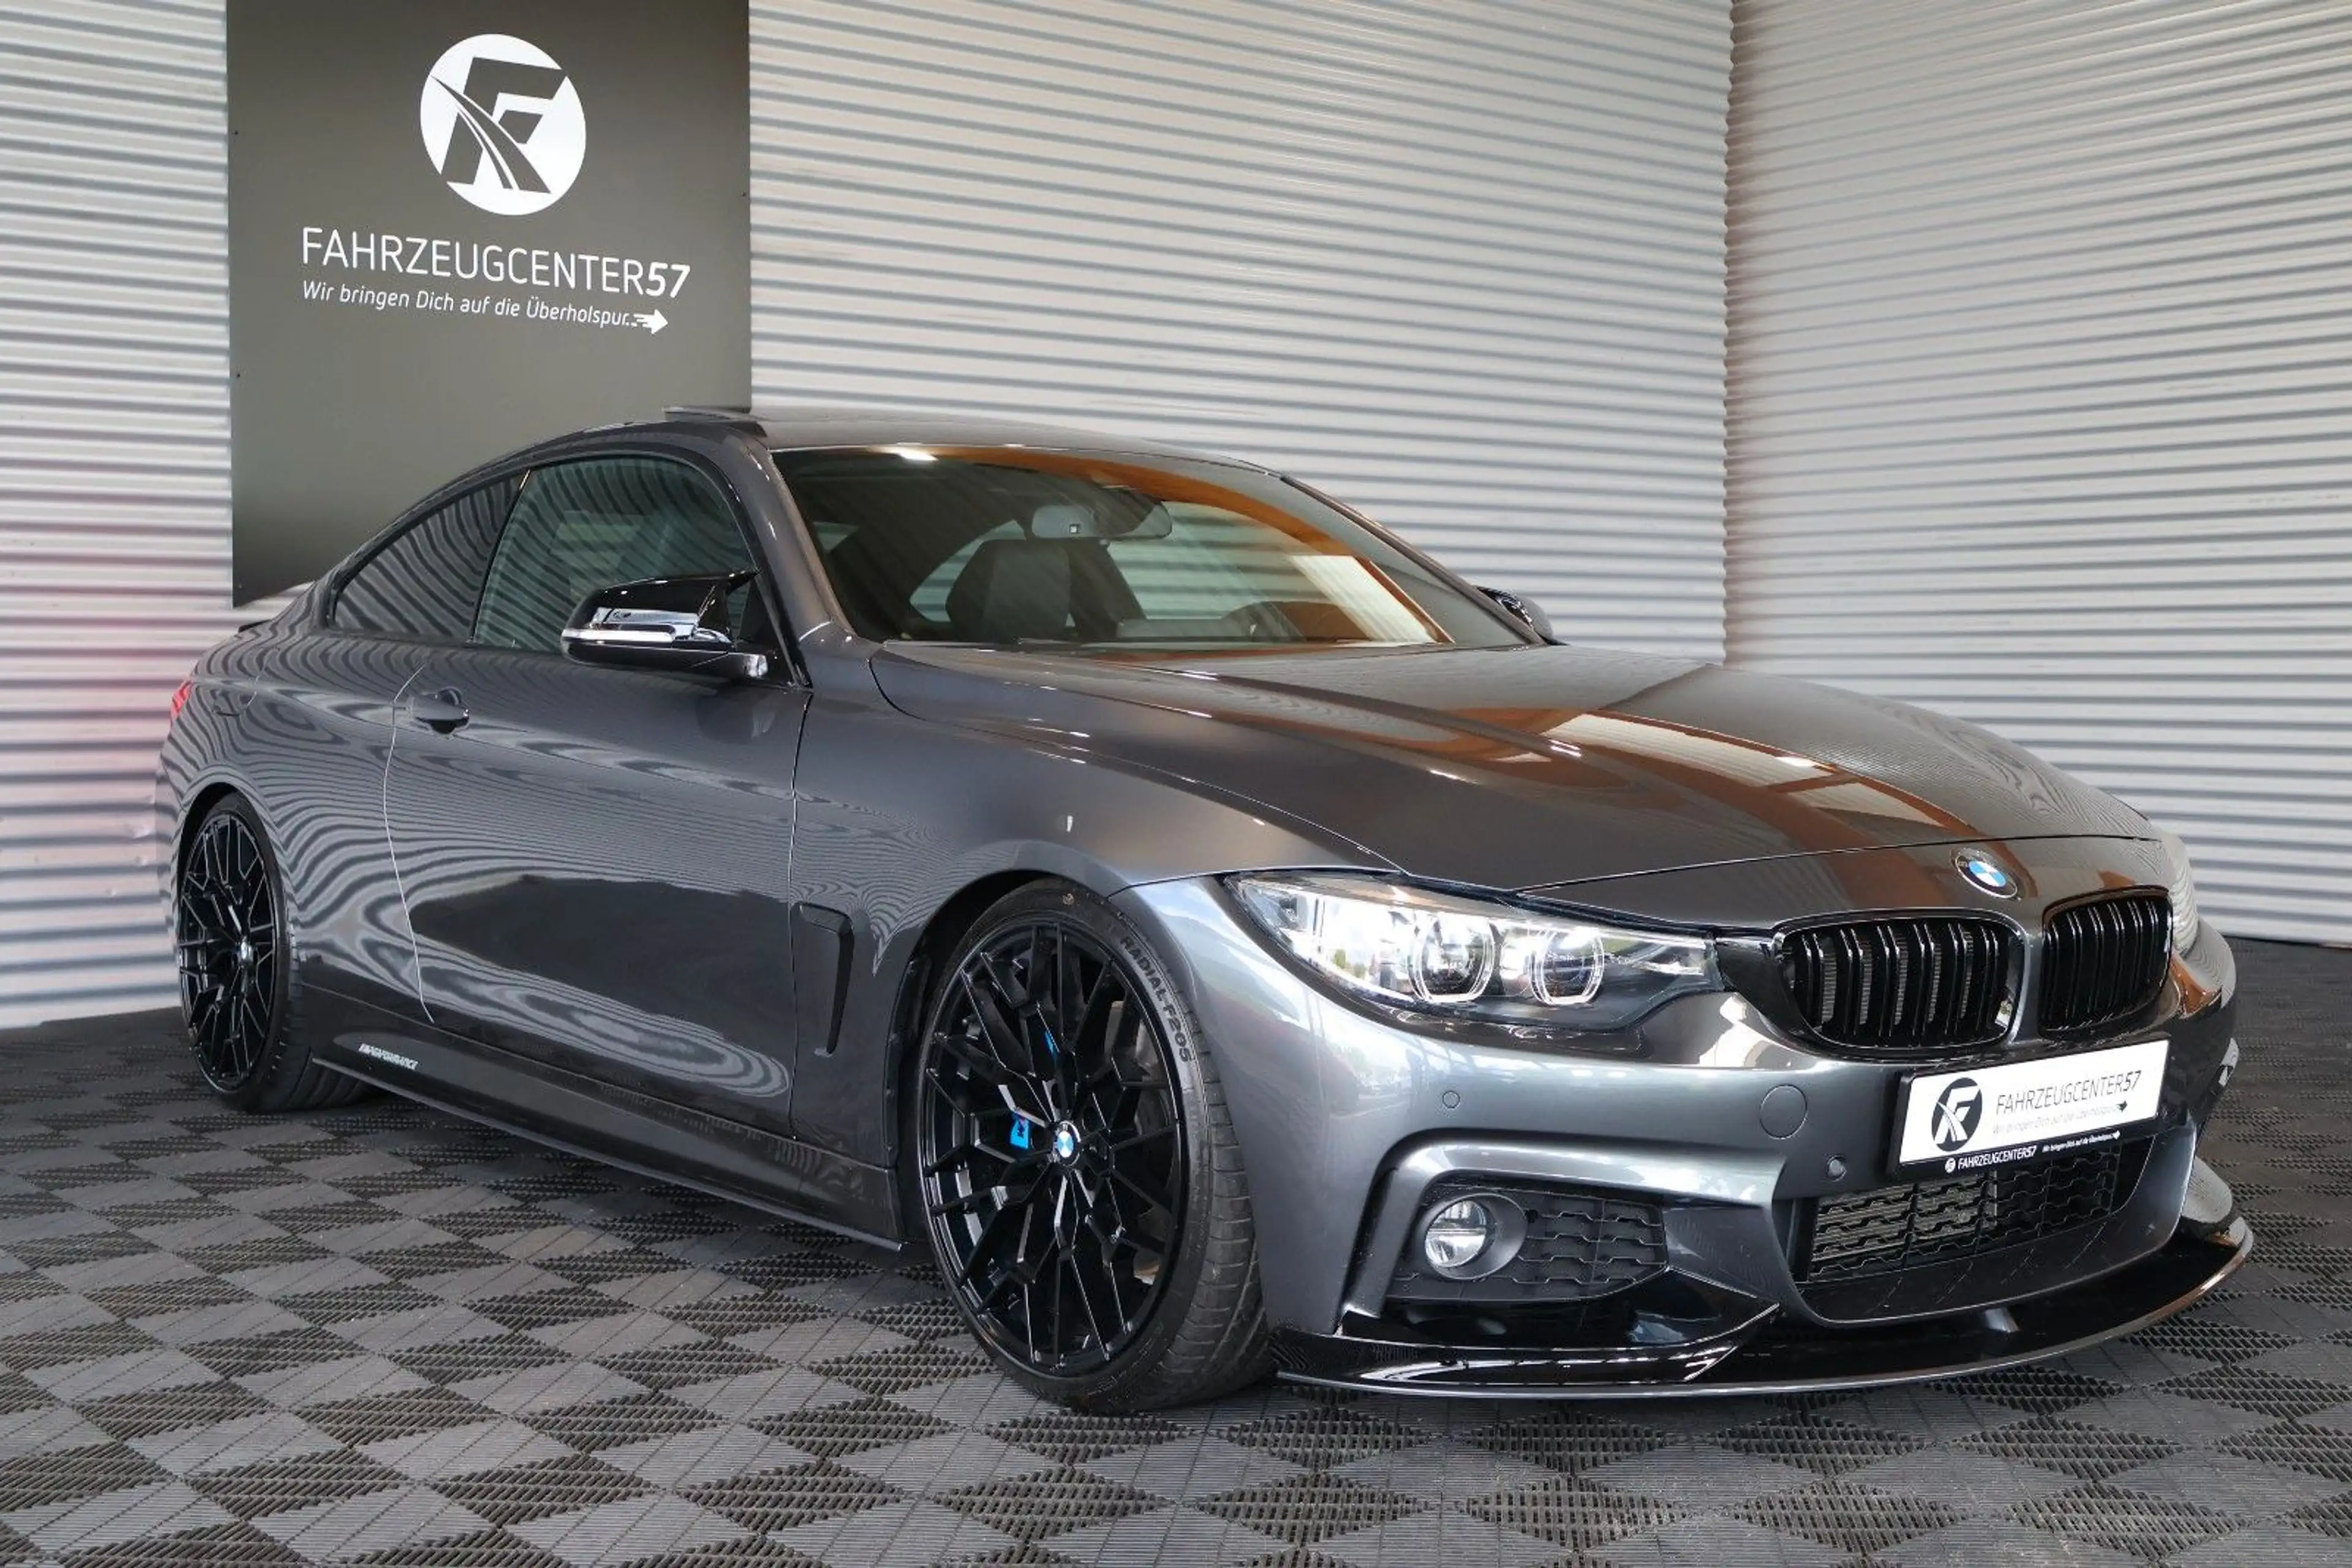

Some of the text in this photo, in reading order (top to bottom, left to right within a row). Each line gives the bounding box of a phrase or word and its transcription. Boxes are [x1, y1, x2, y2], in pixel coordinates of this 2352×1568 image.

[302, 226, 691, 298] FAHRZEUGCENTER57
[303, 279, 334, 301] Wir
[339, 283, 410, 311] bringen
[415, 290, 454, 311] Dich
[459, 296, 491, 314] auf
[494, 297, 521, 317] die
[1120, 936, 1167, 1001] RADIAL
[1996, 1069, 2142, 1115] FAHRZEUGCENTER57
[1957, 1144, 2038, 1170] FAHRZEUGCENTER57
